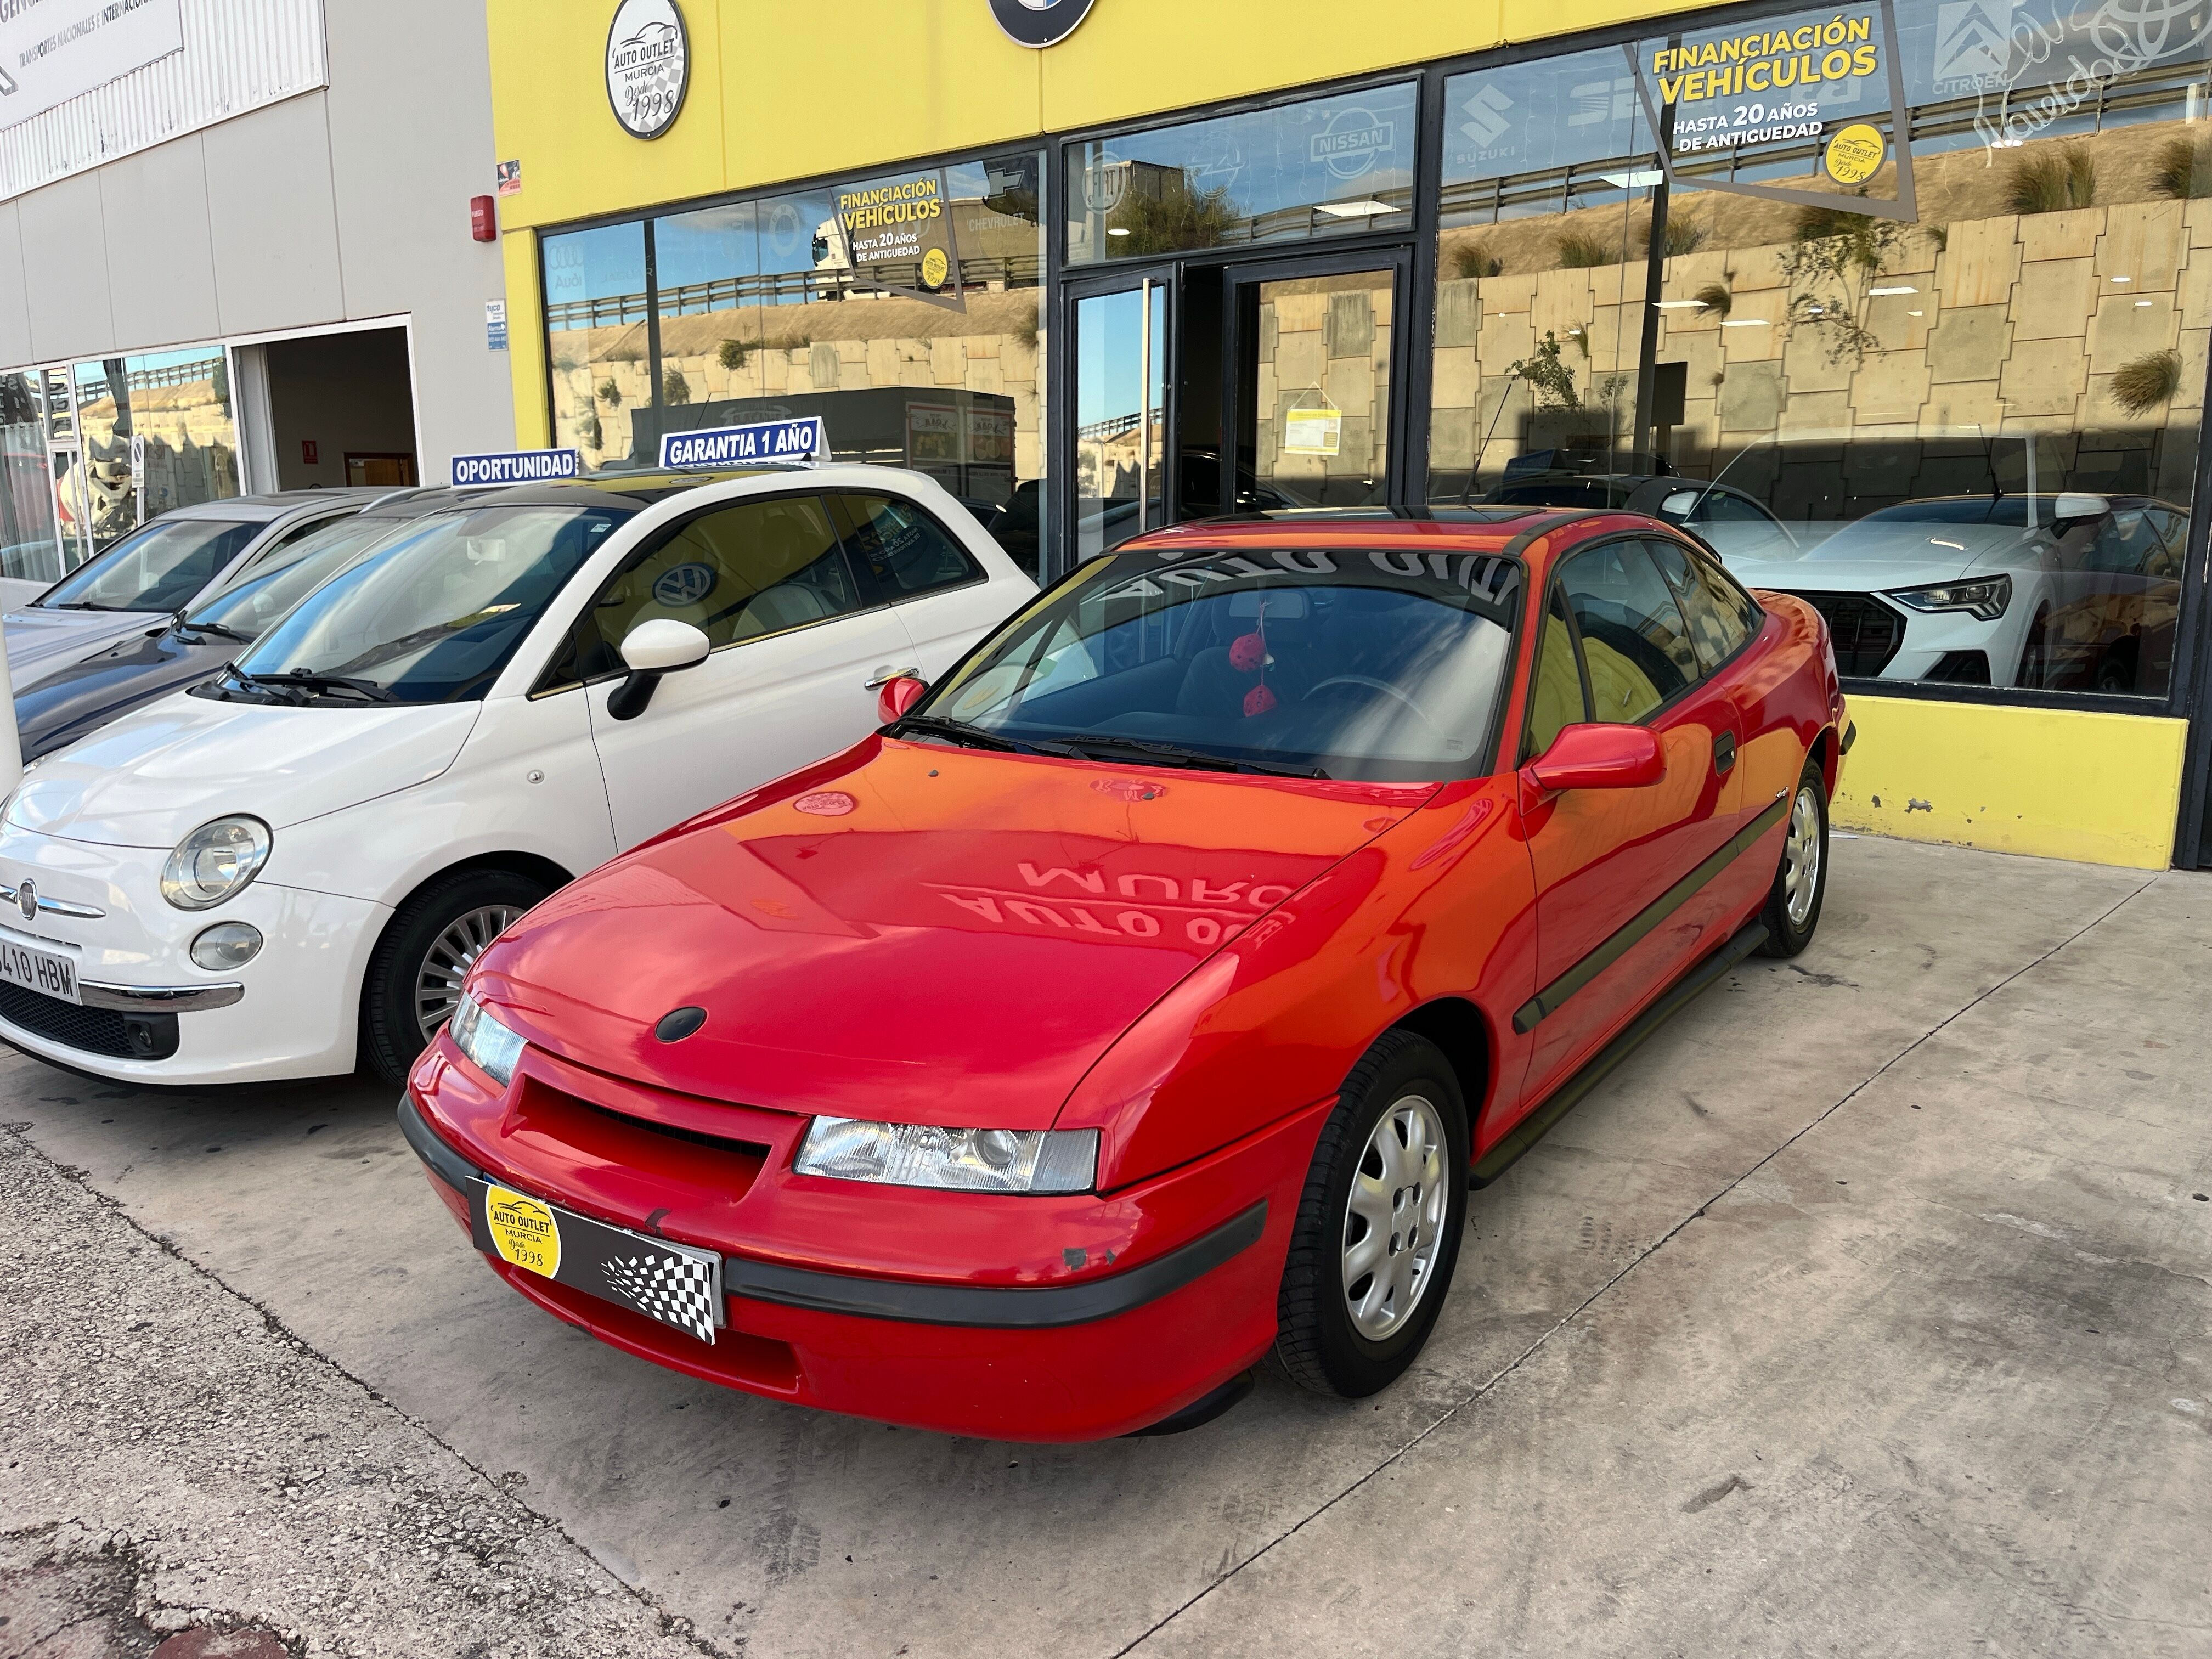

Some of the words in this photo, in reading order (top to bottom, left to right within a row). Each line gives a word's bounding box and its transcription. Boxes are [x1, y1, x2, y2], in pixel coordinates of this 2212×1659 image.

[19, 35, 57, 69] TRANSPORTES
[58, 15, 95, 48] NACIONALES
[97, 12, 100, 29] E
[101, 0, 151, 25] INTERNACIO
[1652, 15, 1872, 74] FINANCIACIÓN
[614, 50, 637, 70] AUTO
[641, 38, 675, 61] OUTLET
[625, 64, 664, 82] MURCIA
[1658, 46, 1877, 104] VEHÍCULOS
[625, 80, 648, 106] Desde
[633, 90, 674, 121] 1998
[1673, 115, 1729, 135] HASTA
[1733, 103, 1765, 127] 20
[1767, 102, 1818, 122] AÑOS
[1319, 129, 1383, 153] NISSAN
[1679, 137, 1703, 153] DE
[1706, 121, 1823, 149] ANTIGUEDAD
[1457, 145, 1515, 165] SUZUKI
[1833, 143, 1851, 152] AUTO
[1853, 148, 1877, 159] OUTLET
[1838, 153, 1865, 163] MURCIA
[1093, 169, 1115, 198] FIAT
[1836, 166, 1866, 180] 1998
[840, 177, 937, 210] FINANCIACIÓN
[844, 197, 941, 231] VEHÍCULOS
[969, 212, 1025, 232] CHEVROLET
[853, 239, 878, 251] HASTA
[879, 233, 894, 247] 20
[894, 233, 917, 245] AÑOS
[856, 253, 867, 262] DE
[869, 246, 921, 261] ANTIGUEDAD
[555, 273, 582, 290] Audi
[487, 304, 501, 313] tyco
[670, 433, 756, 464] GARANTIA
[761, 431, 770, 454] 1
[775, 423, 812, 453] AÑO
[456, 454, 573, 482] OPORTUNIDAD
[0, 945, 32, 983] 410
[35, 955, 74, 997] HBM
[494, 1211, 515, 1226] AUTO
[518, 1216, 550, 1233] OUTLET
[505, 1228, 543, 1244] MURCIA
[515, 1248, 544, 1267] 1998
